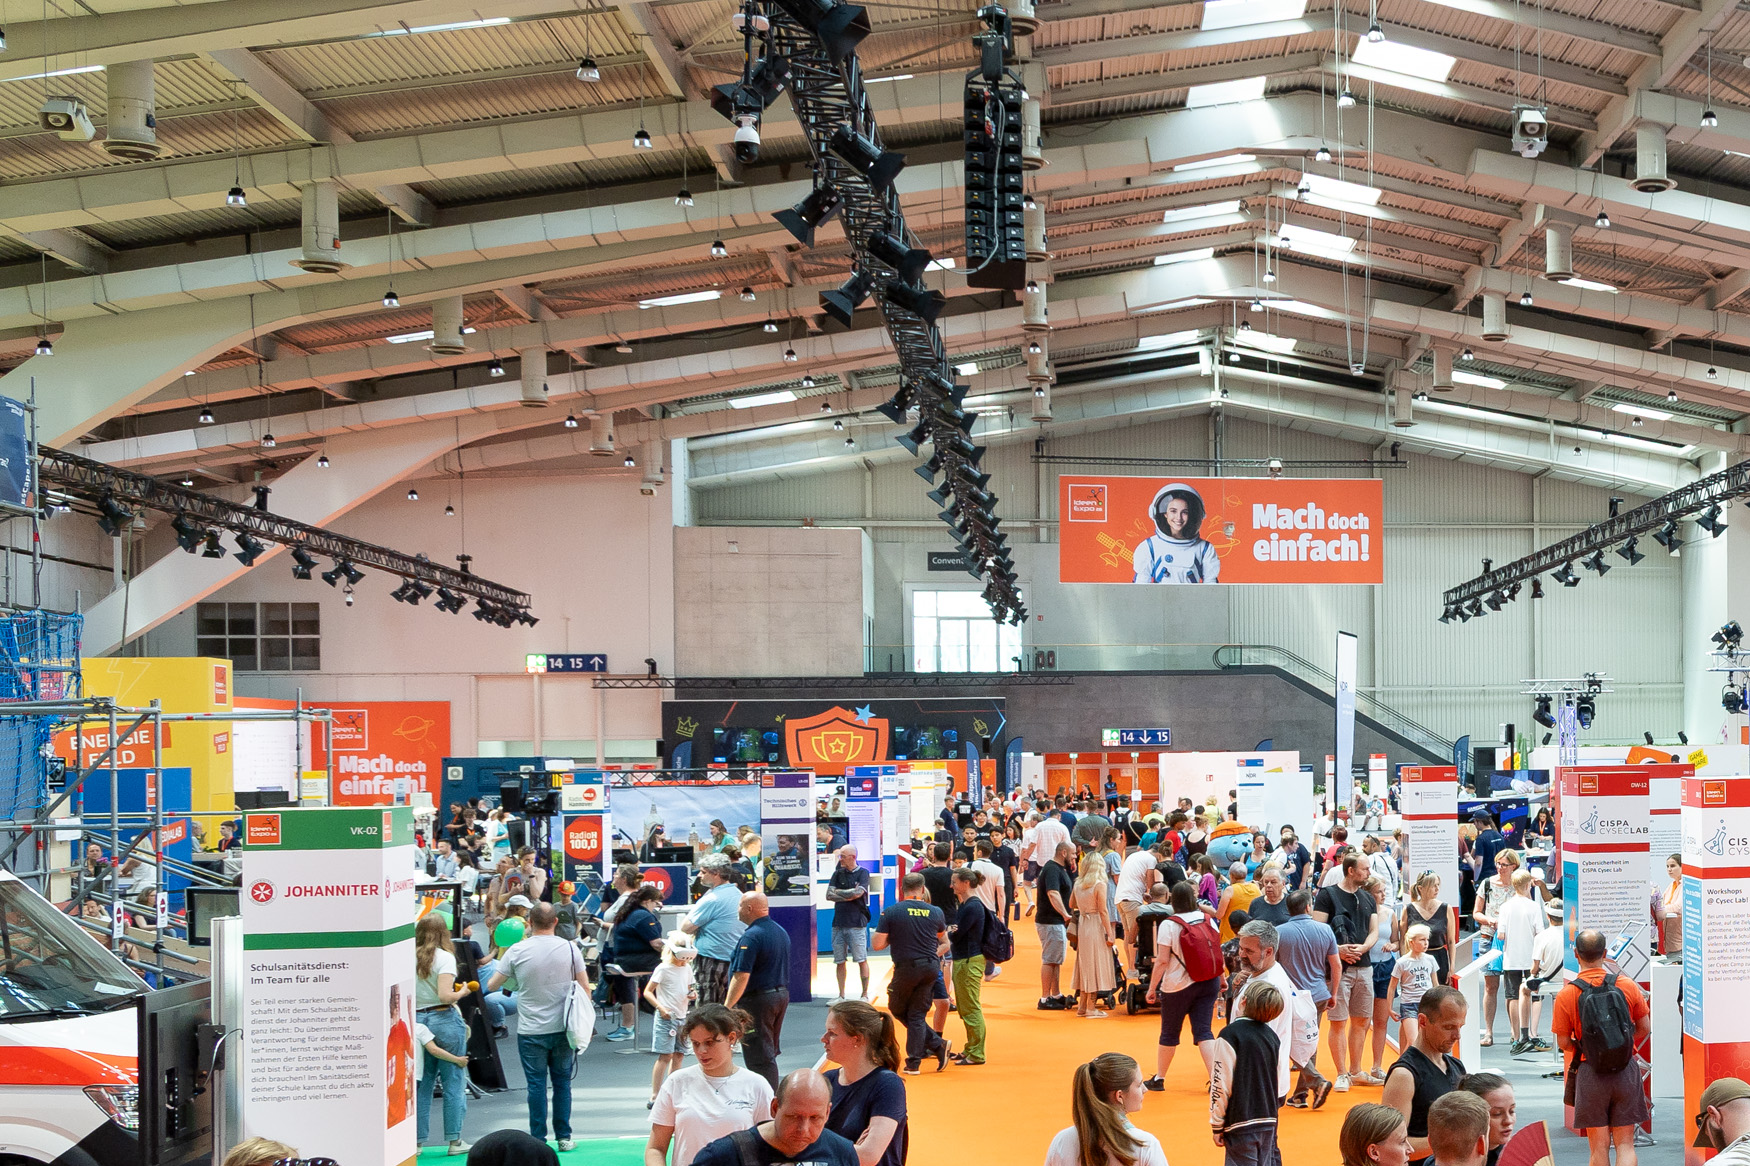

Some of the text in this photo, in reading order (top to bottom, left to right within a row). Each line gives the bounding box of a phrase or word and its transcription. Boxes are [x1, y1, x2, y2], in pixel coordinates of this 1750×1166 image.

[1253, 502, 1369, 530] Mach doch
[1253, 533, 1369, 562] einfach!
[549, 658, 582, 668] 14 15
[1122, 732, 1168, 742] 14 15
[1690, 752, 1703, 762] GAME
[339, 754, 426, 773] Mach doch
[339, 775, 426, 796] einfah!
[162, 827, 183, 842] EDIALAB
[351, 827, 378, 835] VK-02
[569, 831, 597, 840] RadioH
[570, 840, 598, 849] 100,0
[284, 884, 379, 897] JOHANNITER
[907, 908, 930, 917] THW
[251, 962, 349, 972] Schulsanitätsdienst:
[1410, 967, 1429, 975] PALMA
[267, 976, 292, 984] Team
[296, 975, 309, 983] für
[313, 975, 330, 983] alle
